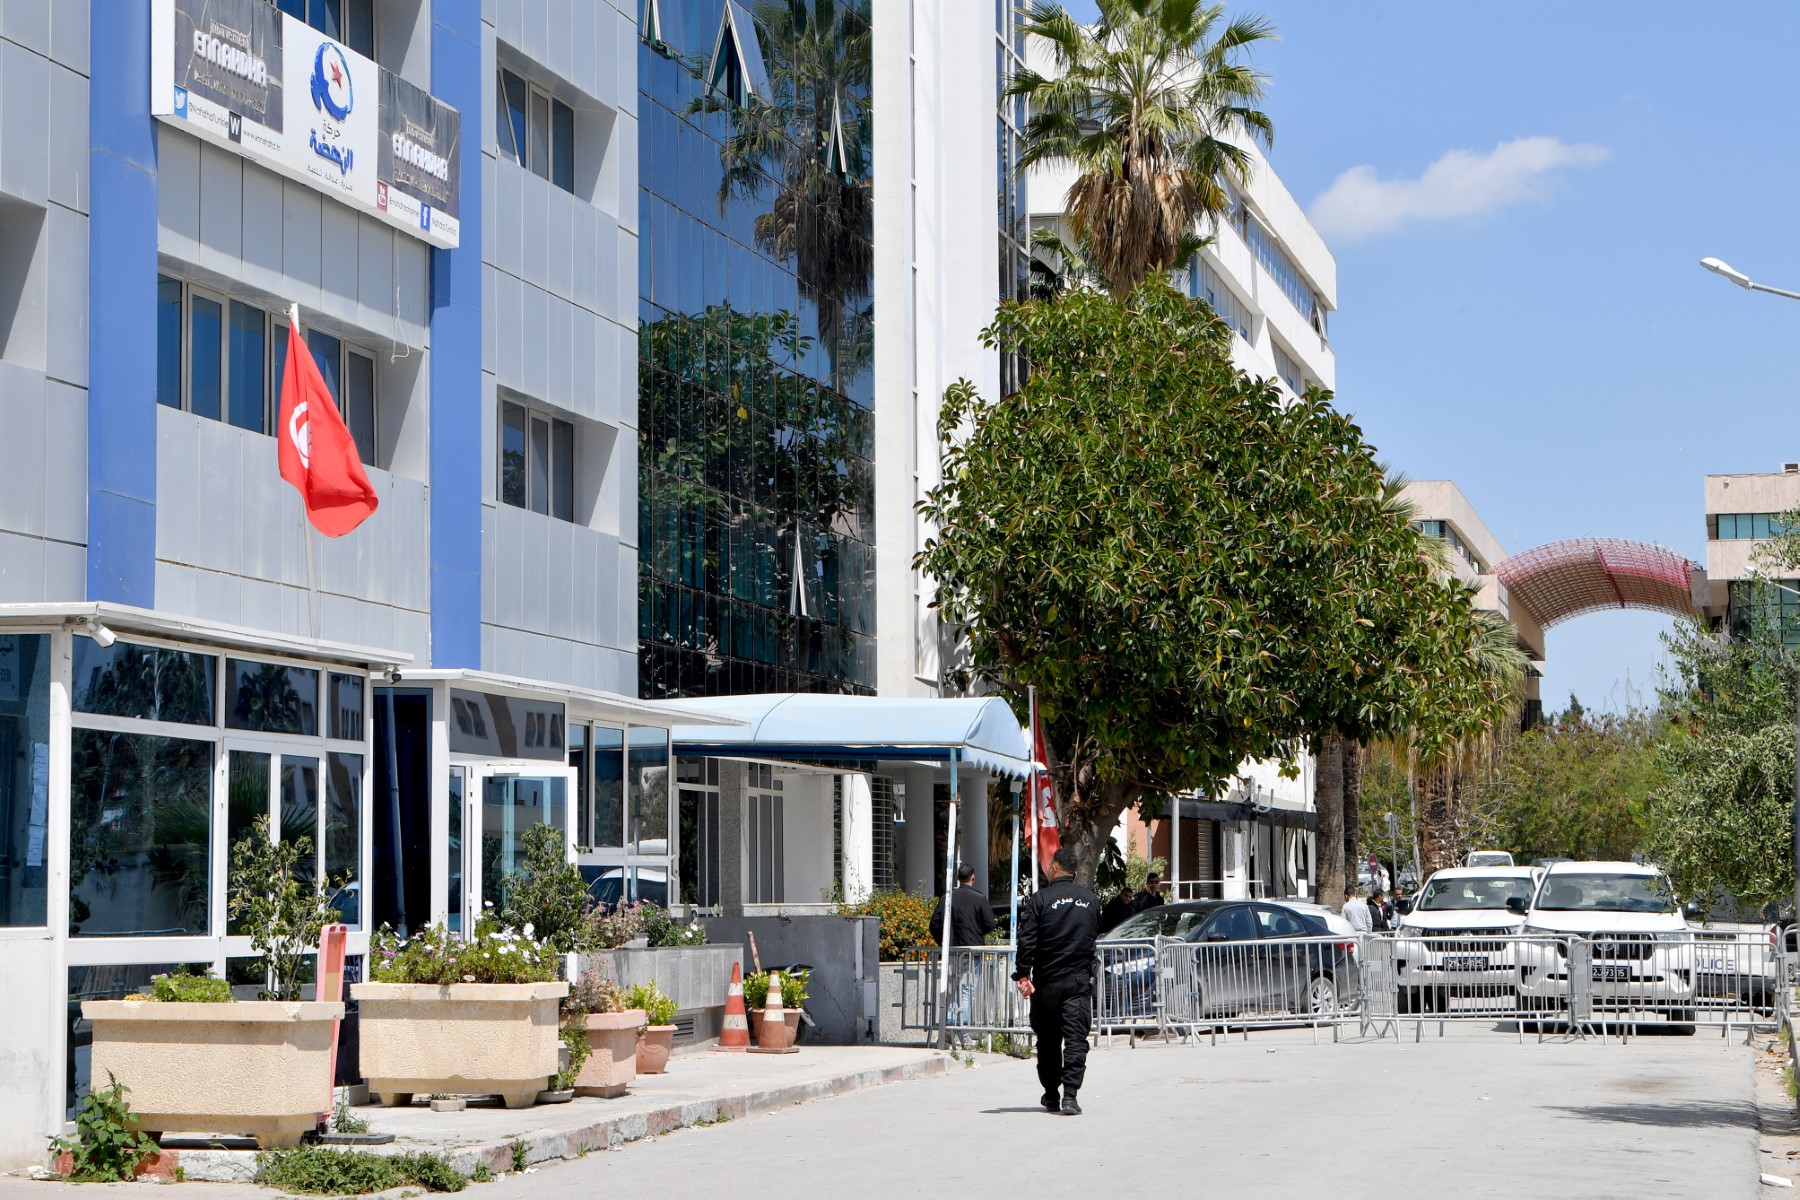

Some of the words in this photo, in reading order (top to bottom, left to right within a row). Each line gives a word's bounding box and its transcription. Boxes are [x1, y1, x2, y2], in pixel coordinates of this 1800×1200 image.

[323, 119, 341, 139] حركة
[310, 128, 353, 175] النهضة
[1695, 958, 1734, 971] OLICE
